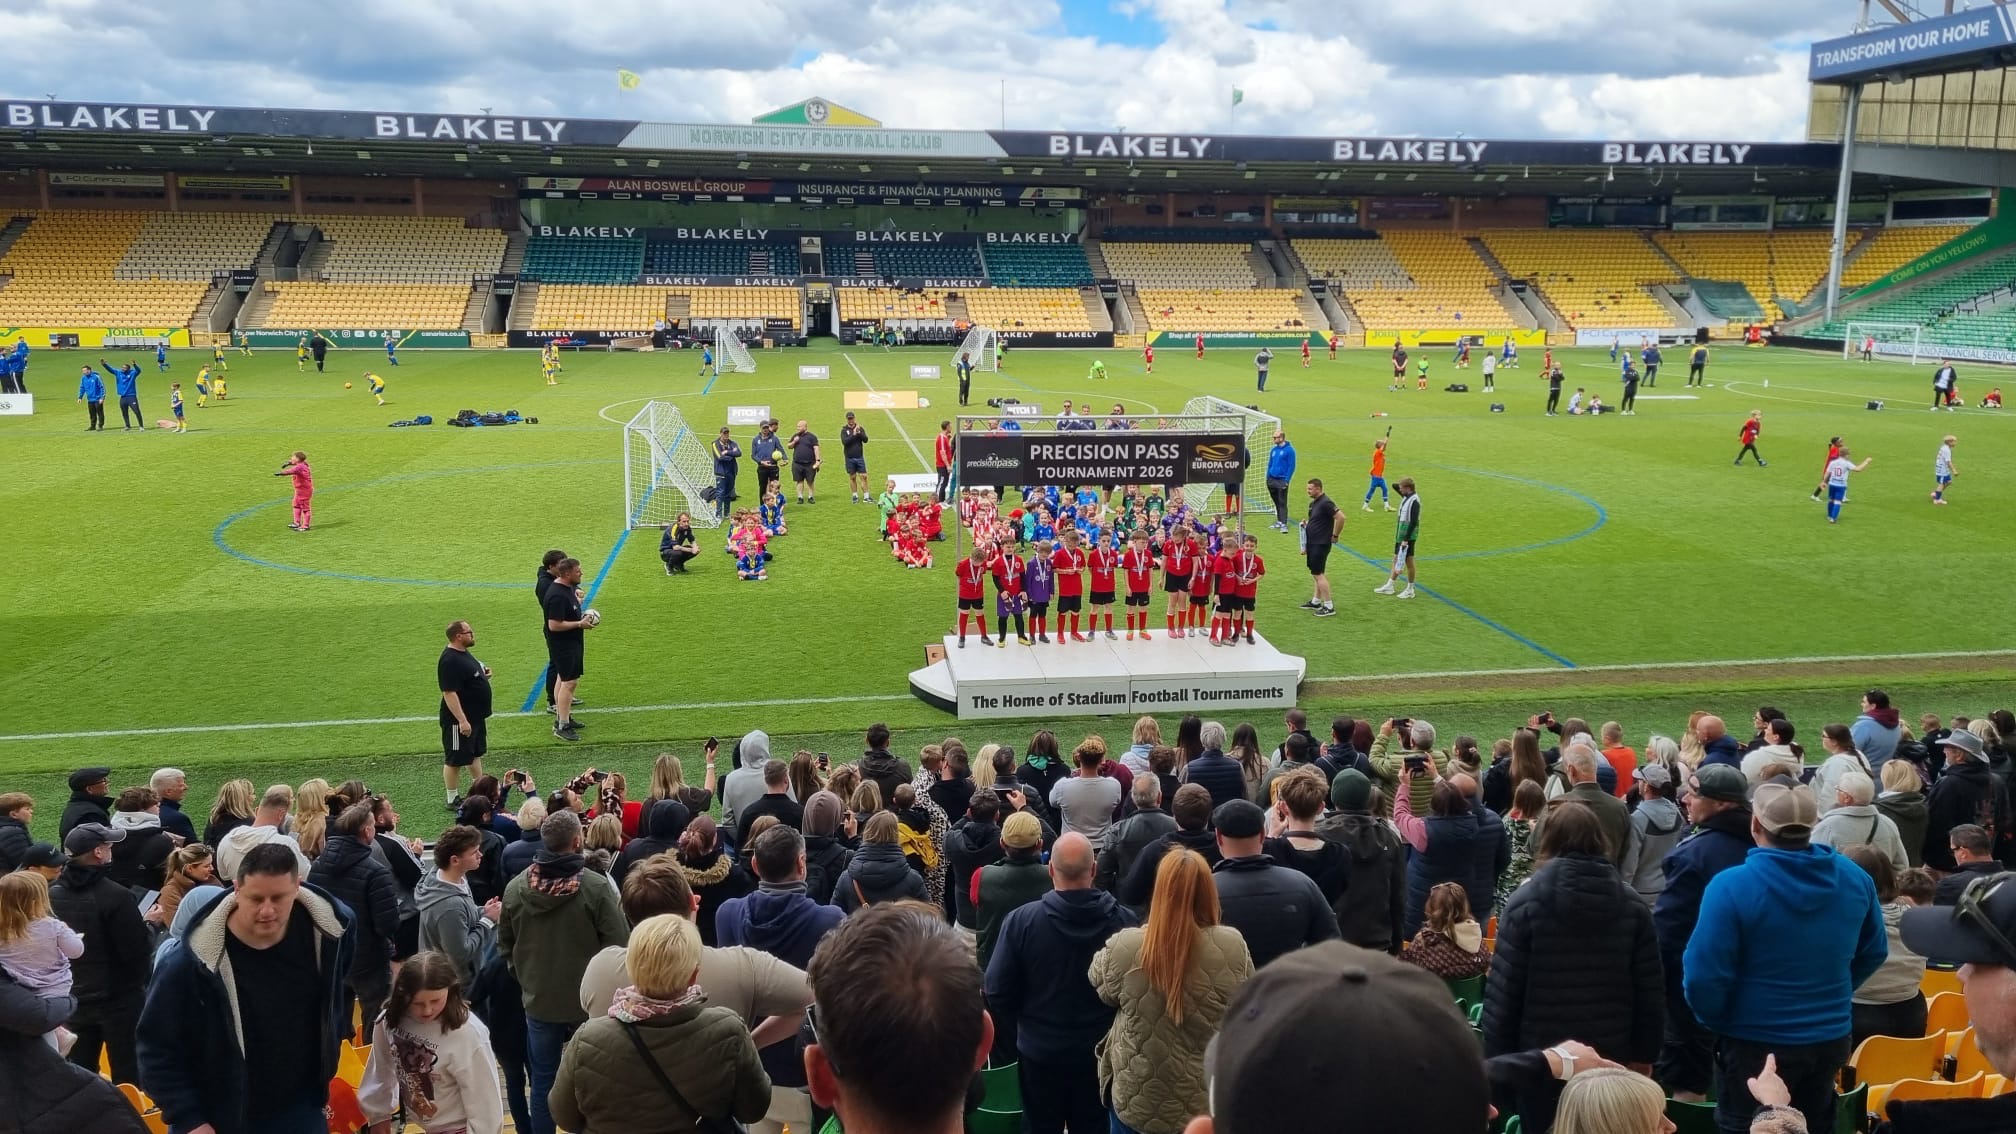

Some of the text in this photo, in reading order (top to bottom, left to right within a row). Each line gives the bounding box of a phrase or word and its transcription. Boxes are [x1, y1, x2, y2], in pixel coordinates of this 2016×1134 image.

[1816, 20, 1990, 67] TRANSFORM YOUR HOME
[8, 104, 215, 131] BLAKELY
[375, 116, 566, 142] BLAKELY
[689, 128, 943, 150] NORWICH CITY FOOTBALL CLUB
[1050, 135, 1211, 158] BLAKELY
[1333, 140, 1487, 162] BLAKELY
[1603, 143, 1751, 165] BLAKELY
[607, 180, 746, 193] ALAN BOSWELL GROUP
[798, 184, 1002, 198] INSURANCE & FINANCIAL PLANNING
[541, 226, 636, 238] BLAKELY
[677, 228, 769, 240] BLAKELY
[856, 231, 944, 242] BLAKELY
[987, 232, 1072, 243] BLAKELY
[1890, 266, 1915, 284] COME
[1915, 260, 1930, 272] ON
[1929, 251, 1948, 265] YOU
[646, 277, 708, 286] BLAKELY
[735, 278, 795, 286] BLAKELY
[925, 280, 982, 288] BLAKELY
[1030, 444, 1180, 461] PRECISION PASS
[966, 457, 1019, 469] precisionpass
[1192, 461, 1240, 469] EUROPA CUP
[1037, 466, 1174, 479] TOURNAMENT 2026
[913, 481, 938, 489] precis
[971, 686, 1284, 709] The Home of Stadium Football Tournaments
